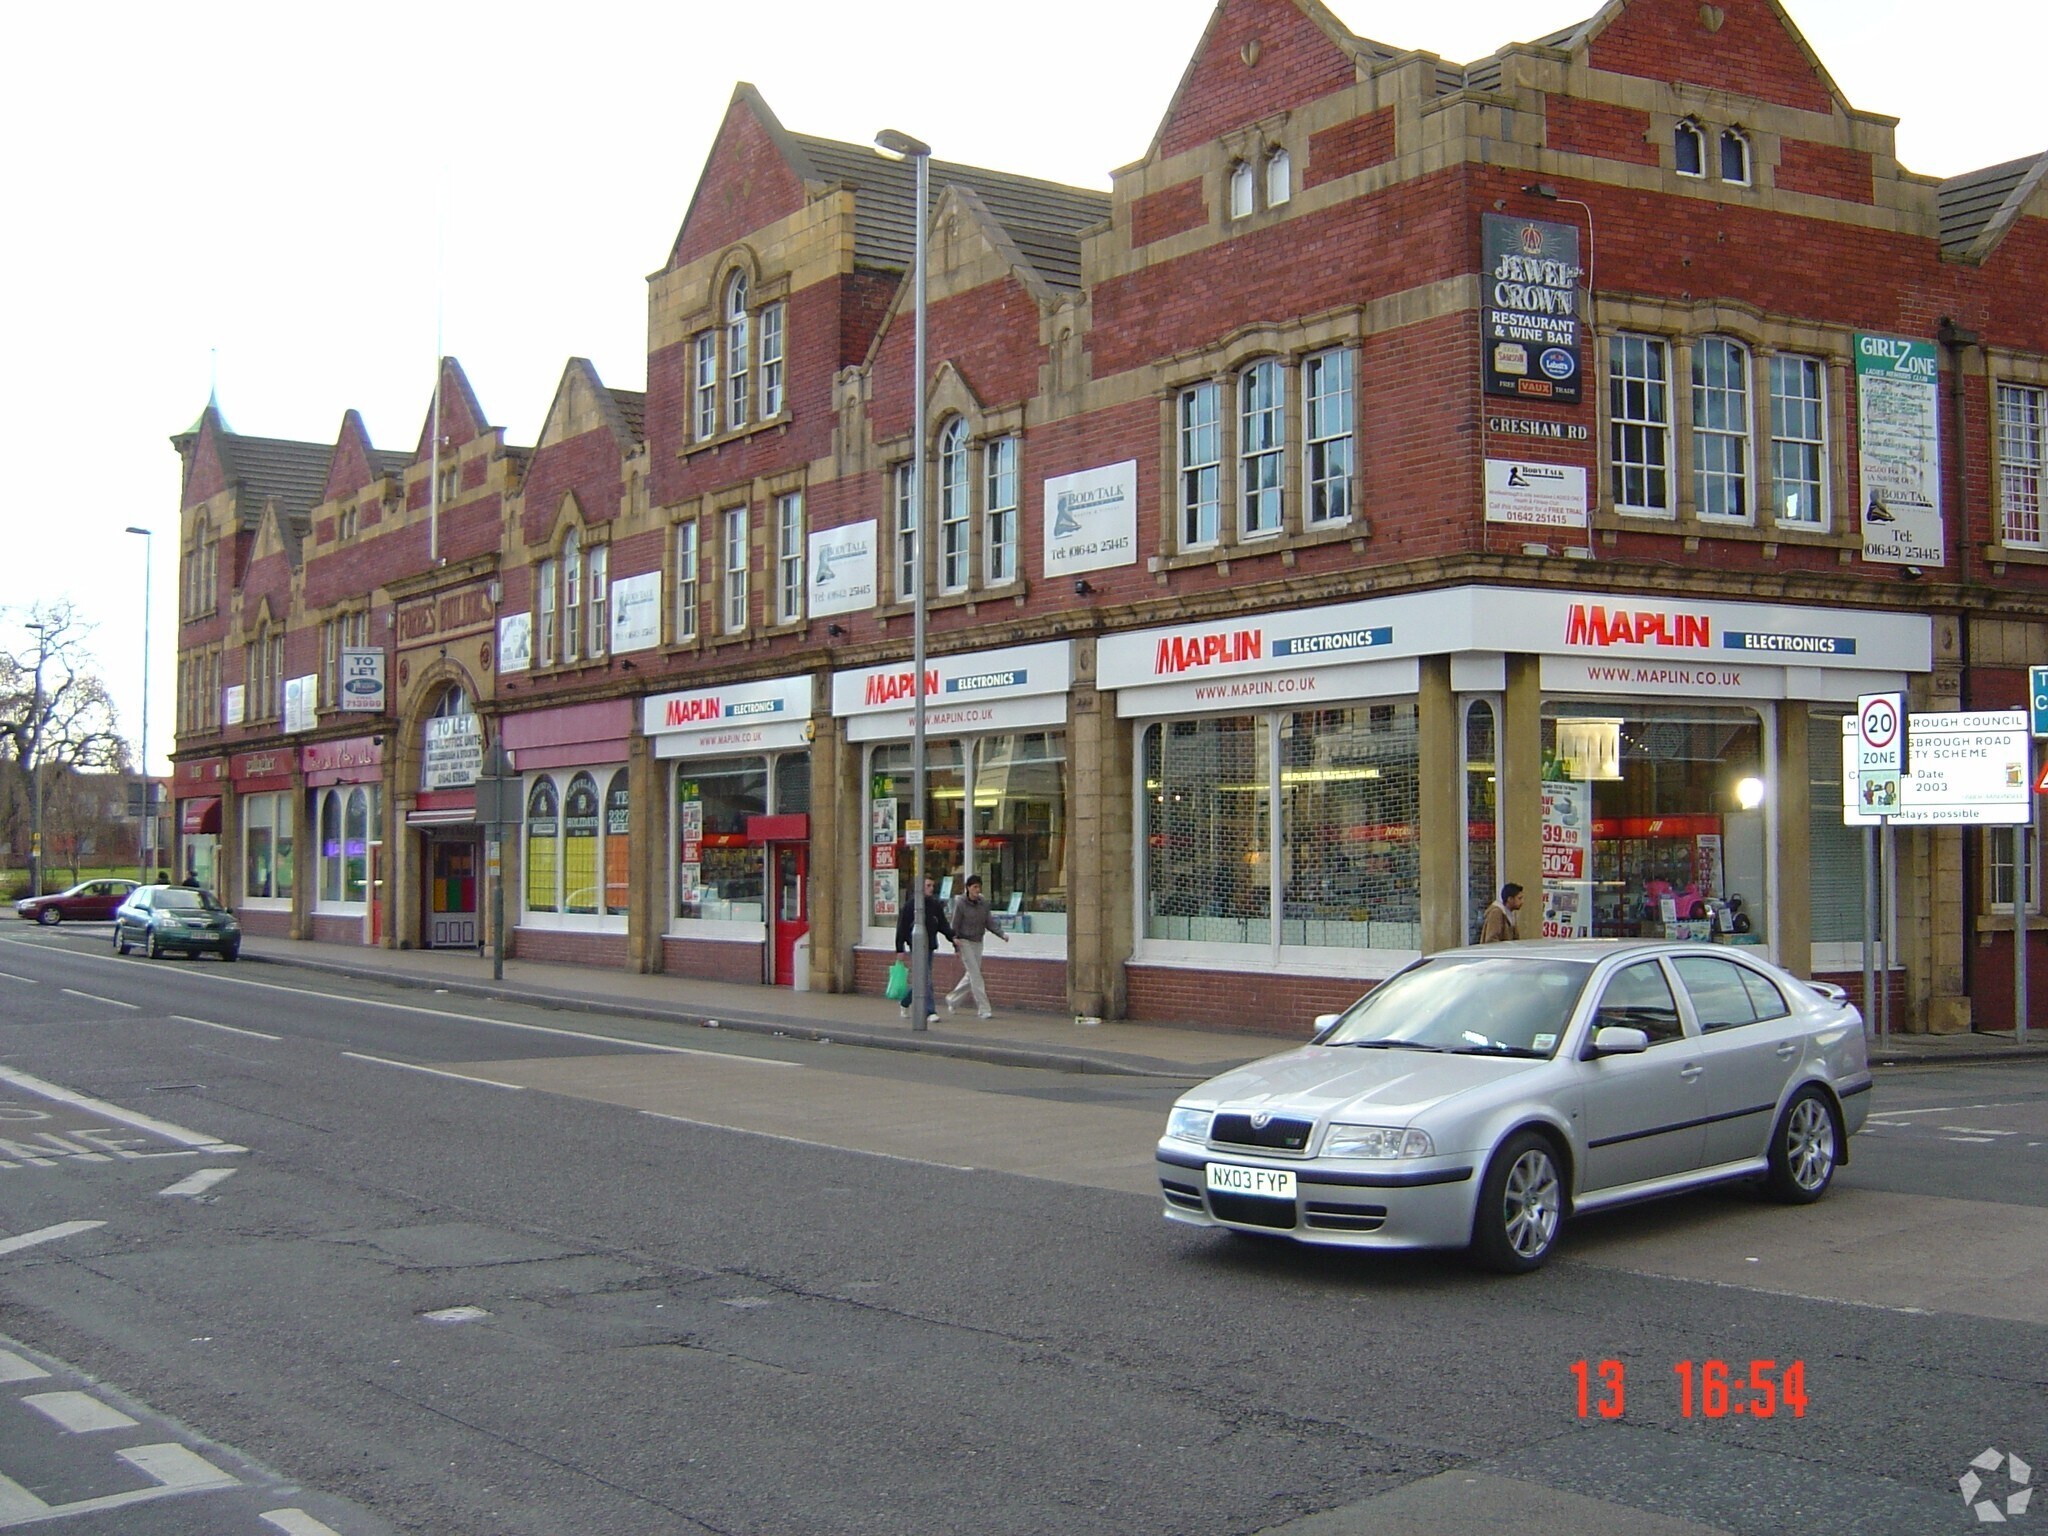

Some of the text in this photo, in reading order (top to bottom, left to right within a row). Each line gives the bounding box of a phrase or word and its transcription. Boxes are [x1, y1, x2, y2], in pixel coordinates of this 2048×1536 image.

[1495, 254, 1573, 289] JEWEL
[1494, 281, 1573, 316] CROWN
[1491, 311, 1575, 333] RESTAURANT
[1495, 324, 1573, 346] & WINE BAR
[1912, 374, 1928, 382] CLUB
[1499, 379, 1575, 395] FREE VAUX TRADE
[1490, 417, 1588, 440] GRESHAM RD
[1506, 511, 1567, 525] 01642 251415
[1512, 504, 1534, 512] number
[1548, 506, 1564, 514] FREE
[1565, 508, 1584, 516] TRIAL
[1100, 536, 1129, 552] 251415
[1892, 530, 1913, 543] Tel:
[1865, 543, 1940, 560] (01642) 251415
[1564, 603, 1836, 653] MAPLIN ELECTRONICS
[1154, 628, 1373, 675] MAPLIN ELECTRONICS
[353, 656, 374, 666] TO
[350, 667, 377, 676] LET
[1587, 666, 1741, 686] WWW.MAPLIN.CO.UK
[957, 672, 1015, 690] ELECTRONICS
[1195, 676, 1317, 700] WWW.MAPLIN.CO.UK
[665, 696, 775, 727] MAPLIN ELECTRONICS
[908, 708, 993, 727] WW.MAPLIN.CO.UK
[437, 715, 472, 737] TO LET
[1867, 713, 1893, 733] 20
[1963, 716, 2023, 727] COUNCIL
[700, 732, 762, 746] WWW.MAPLIN.CO.UK
[1976, 736, 2011, 746] ROAD
[1863, 752, 1896, 765] ZONE
[1934, 749, 1988, 759] SCHEME
[1917, 769, 1944, 779] Date
[1915, 782, 1948, 792] 2003
[1933, 809, 1980, 820] possible
[1542, 854, 1575, 872] 50%
[1213, 1167, 1288, 1192] NX03 FYP
